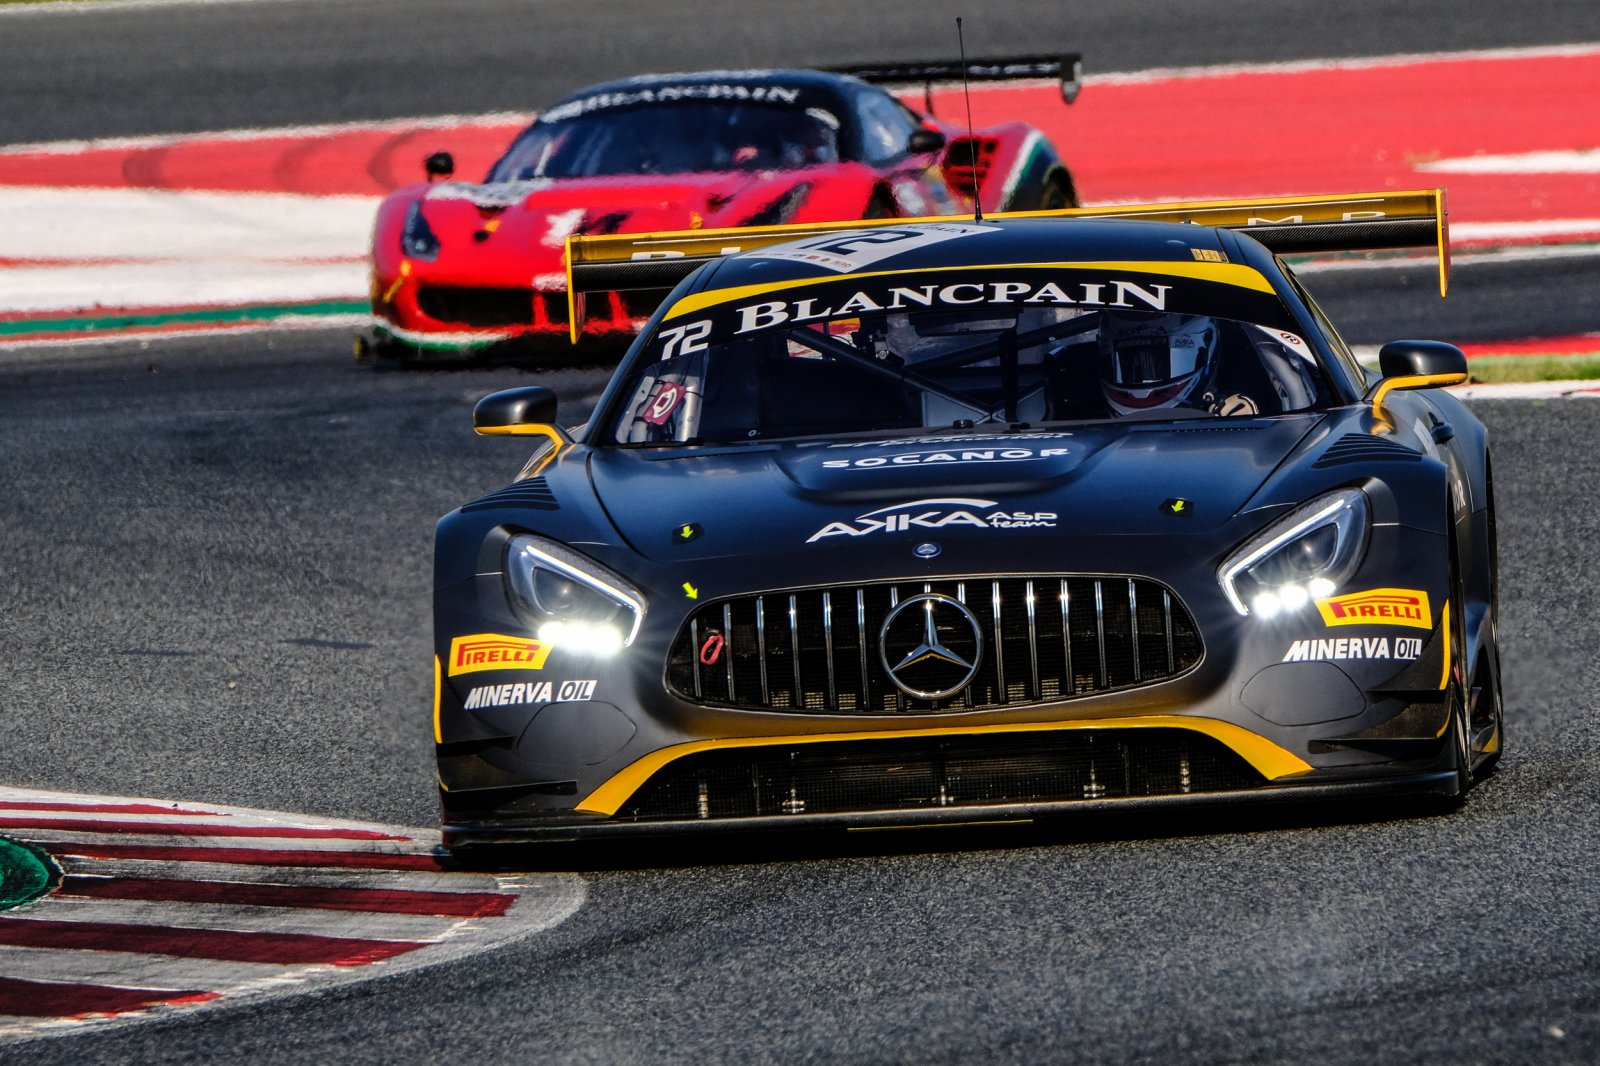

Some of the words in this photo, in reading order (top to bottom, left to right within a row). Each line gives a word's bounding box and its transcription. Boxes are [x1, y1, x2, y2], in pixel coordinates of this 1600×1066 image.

[733, 280, 1172, 335] BLANCPAIN
[657, 319, 712, 361] 72
[823, 448, 1070, 469] SOCANOR
[986, 511, 1058, 521] ASP
[990, 518, 1057, 528] team
[1328, 595, 1422, 620] PIRELLI
[456, 640, 541, 667] PIRELLI
[1282, 637, 1390, 662] MINERVA
[1395, 638, 1421, 660] OIL
[464, 682, 552, 710] MINERVA
[558, 680, 596, 701] OIL
